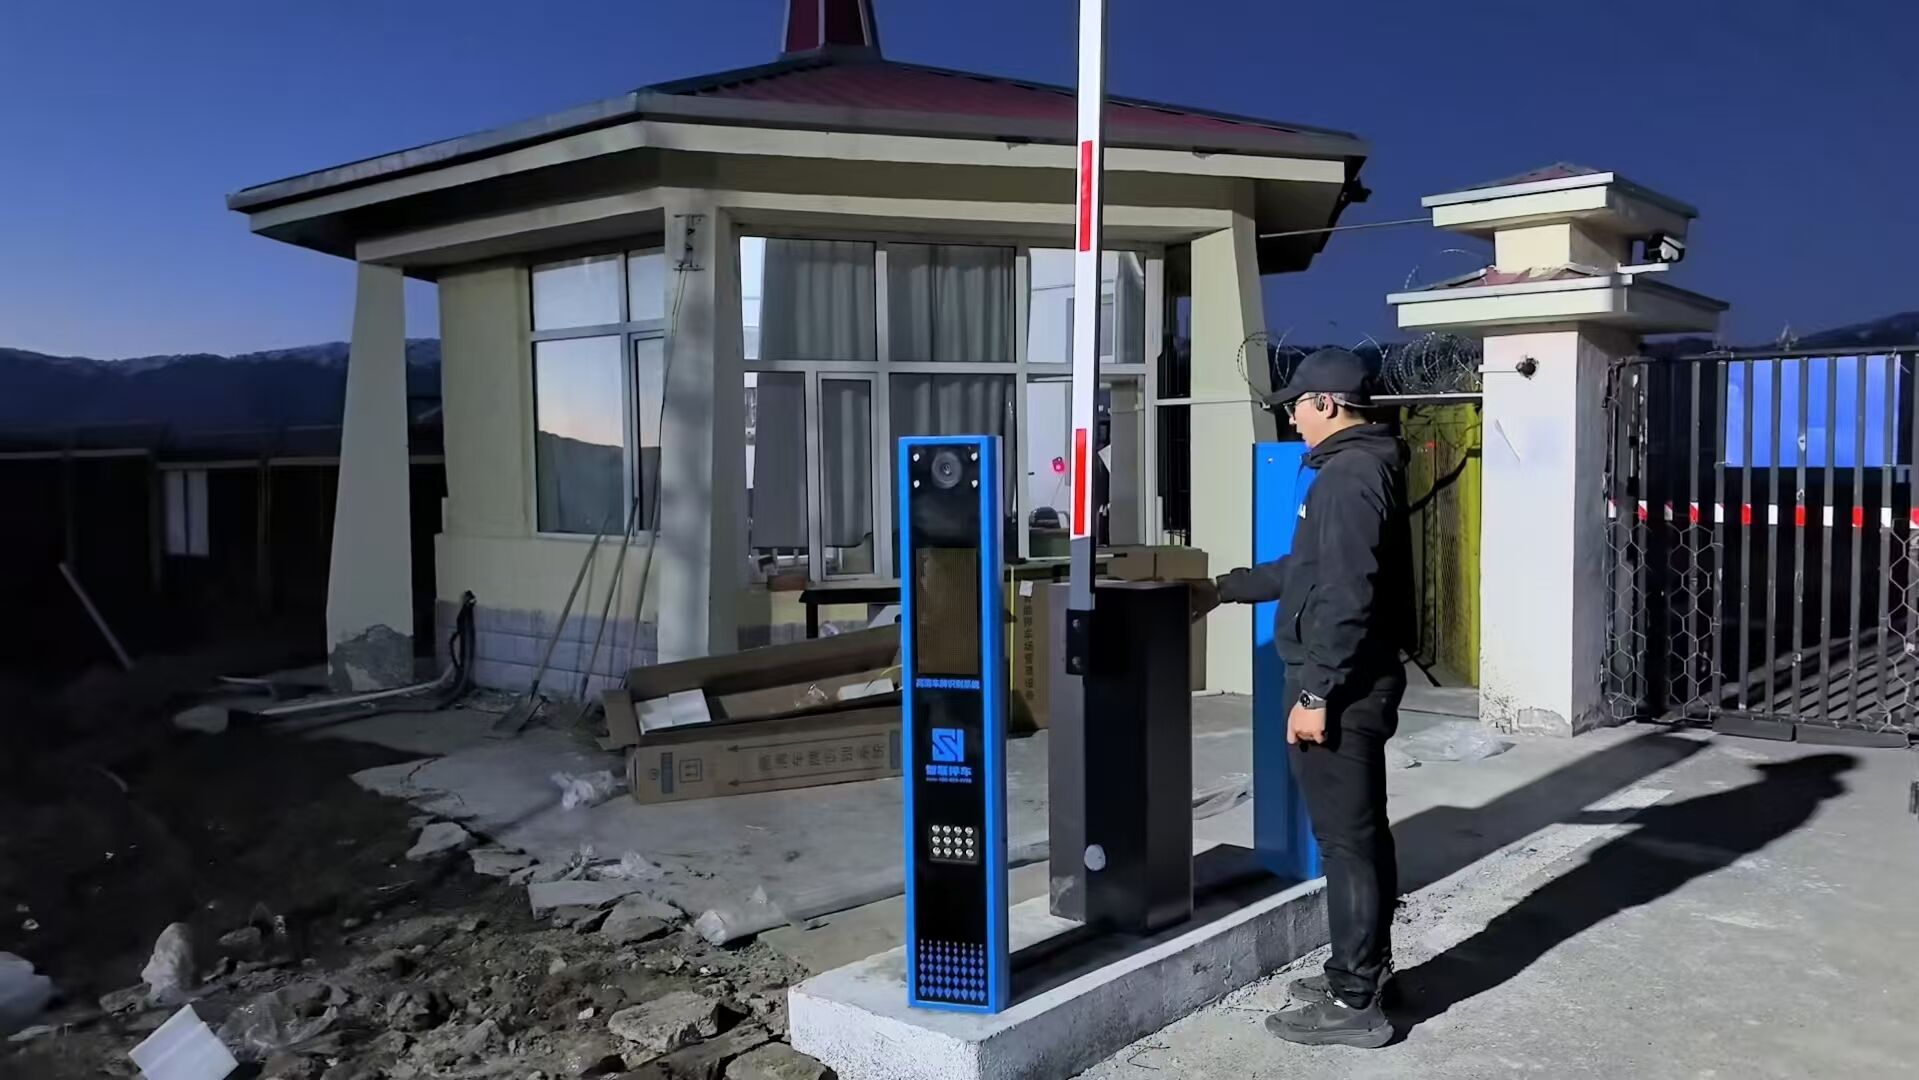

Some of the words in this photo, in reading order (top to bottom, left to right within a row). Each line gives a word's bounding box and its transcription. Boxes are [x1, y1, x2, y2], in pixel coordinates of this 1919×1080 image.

[916, 678, 980, 690] 高清车牌识别系统
